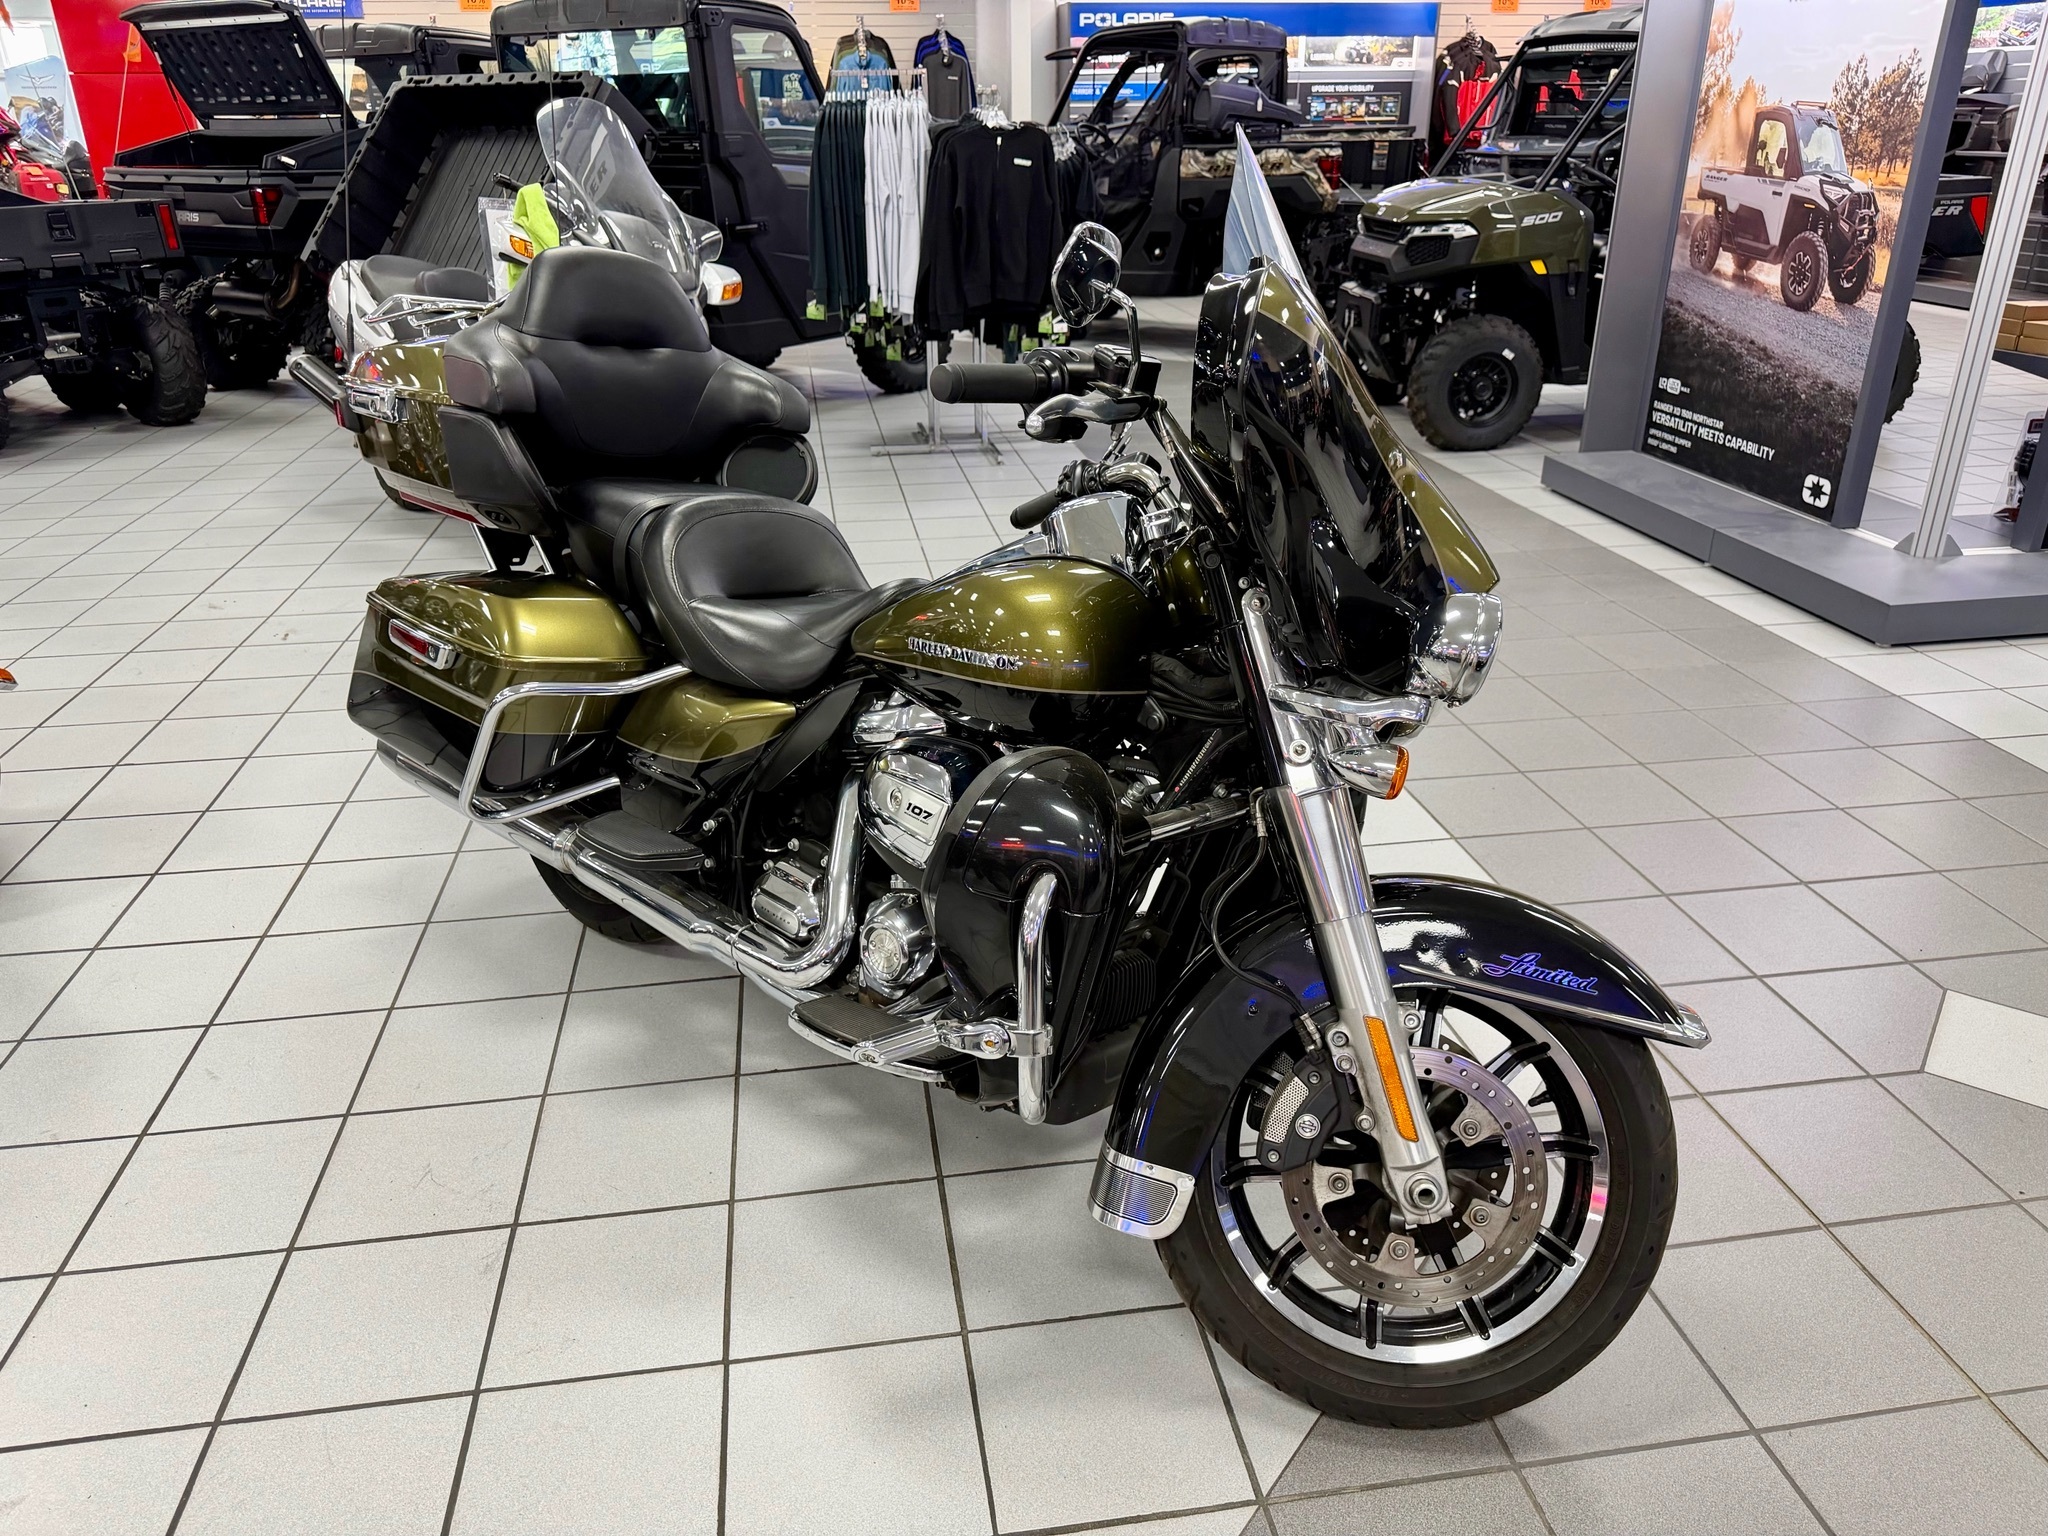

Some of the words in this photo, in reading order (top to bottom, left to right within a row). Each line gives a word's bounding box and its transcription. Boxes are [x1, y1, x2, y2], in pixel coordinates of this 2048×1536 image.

[1335, 84, 1348, 92] YOUR
[1520, 211, 1563, 227] 500
[1653, 400, 1673, 413] RANGER
[1673, 406, 1681, 416] XD
[1681, 408, 1692, 420] 1500
[1692, 412, 1724, 430] NORTHSTAR
[1652, 410, 1698, 436] VERSATILITY
[1697, 425, 1725, 445] MEETS
[1724, 434, 1776, 461] CAPABILITY
[906, 802, 933, 820] 107
[1480, 952, 1598, 995] Limited
